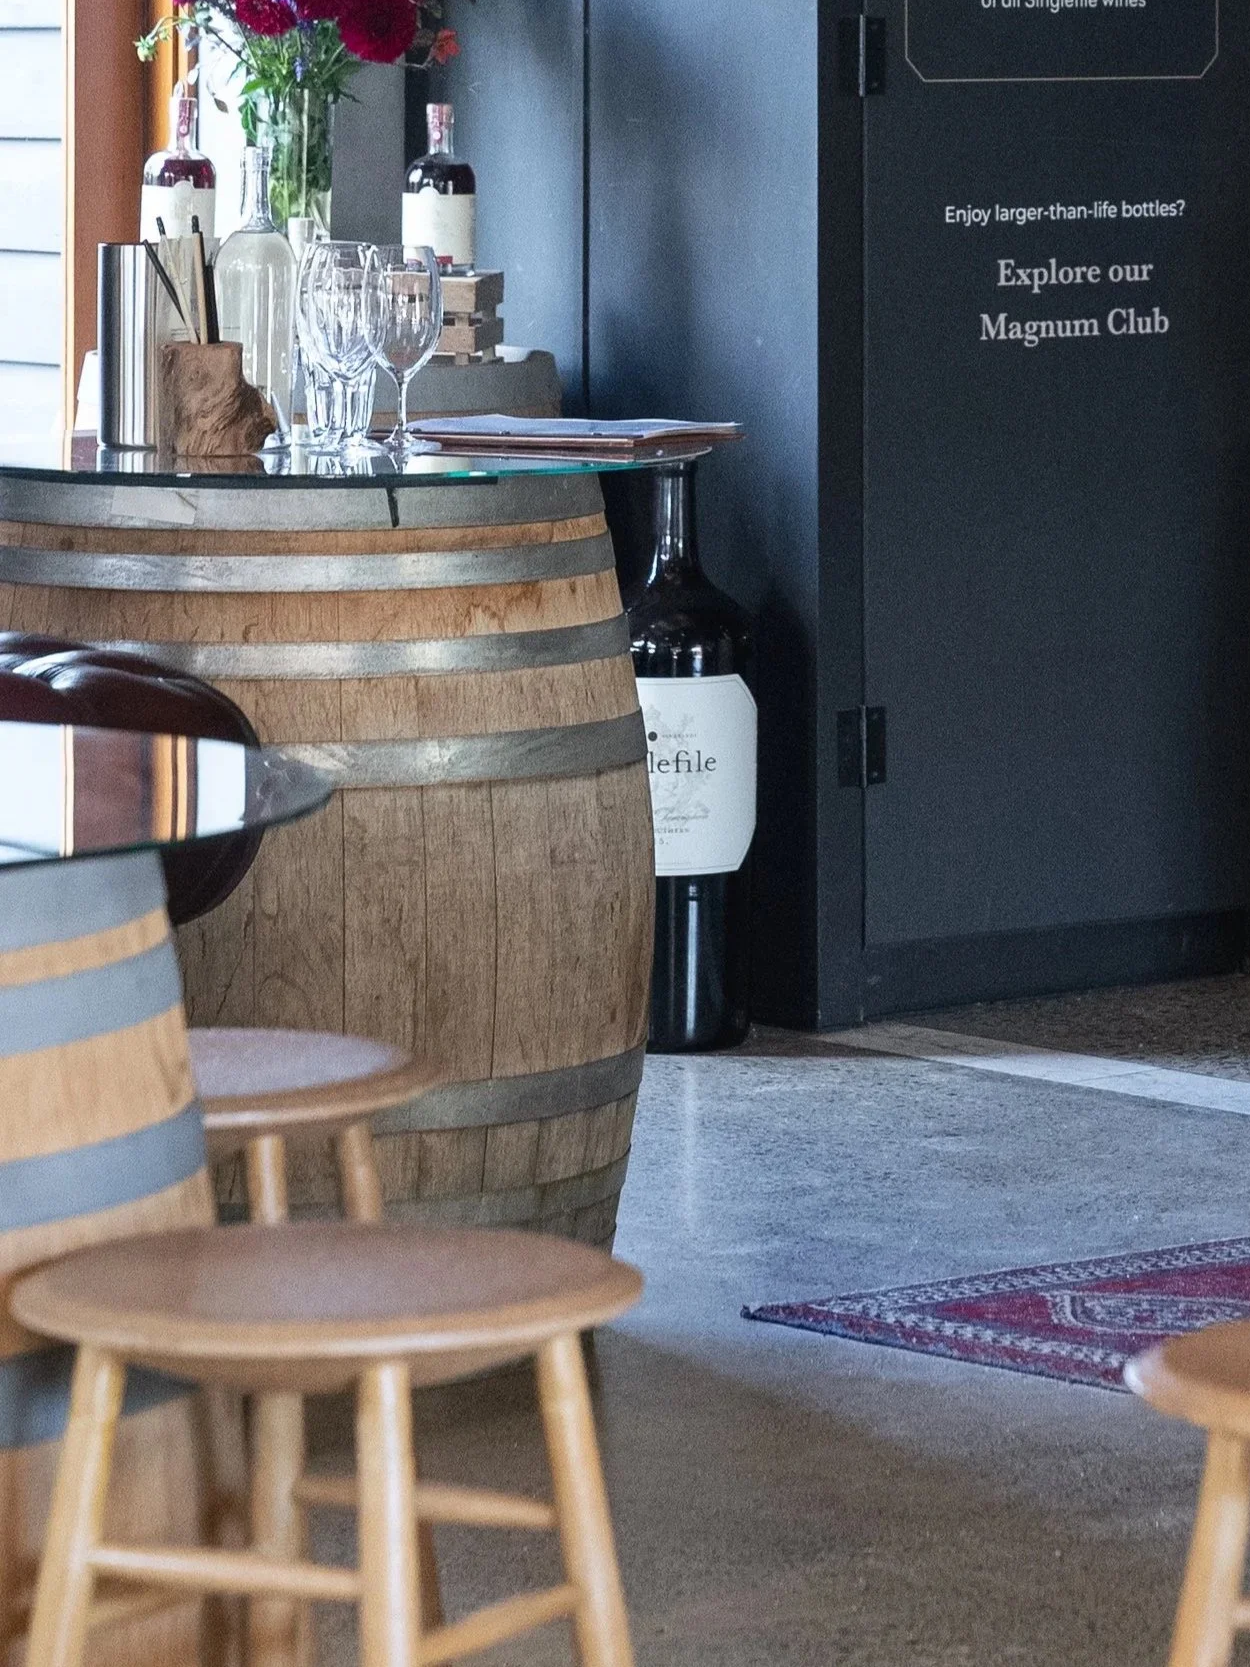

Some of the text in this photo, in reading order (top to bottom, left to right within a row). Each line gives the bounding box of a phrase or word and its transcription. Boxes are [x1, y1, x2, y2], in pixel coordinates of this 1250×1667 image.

[945, 199, 1185, 226] Enjoy larger-than-life bottles?
[998, 258, 1153, 293] Explore our
[980, 307, 1169, 347] Magnum Club
